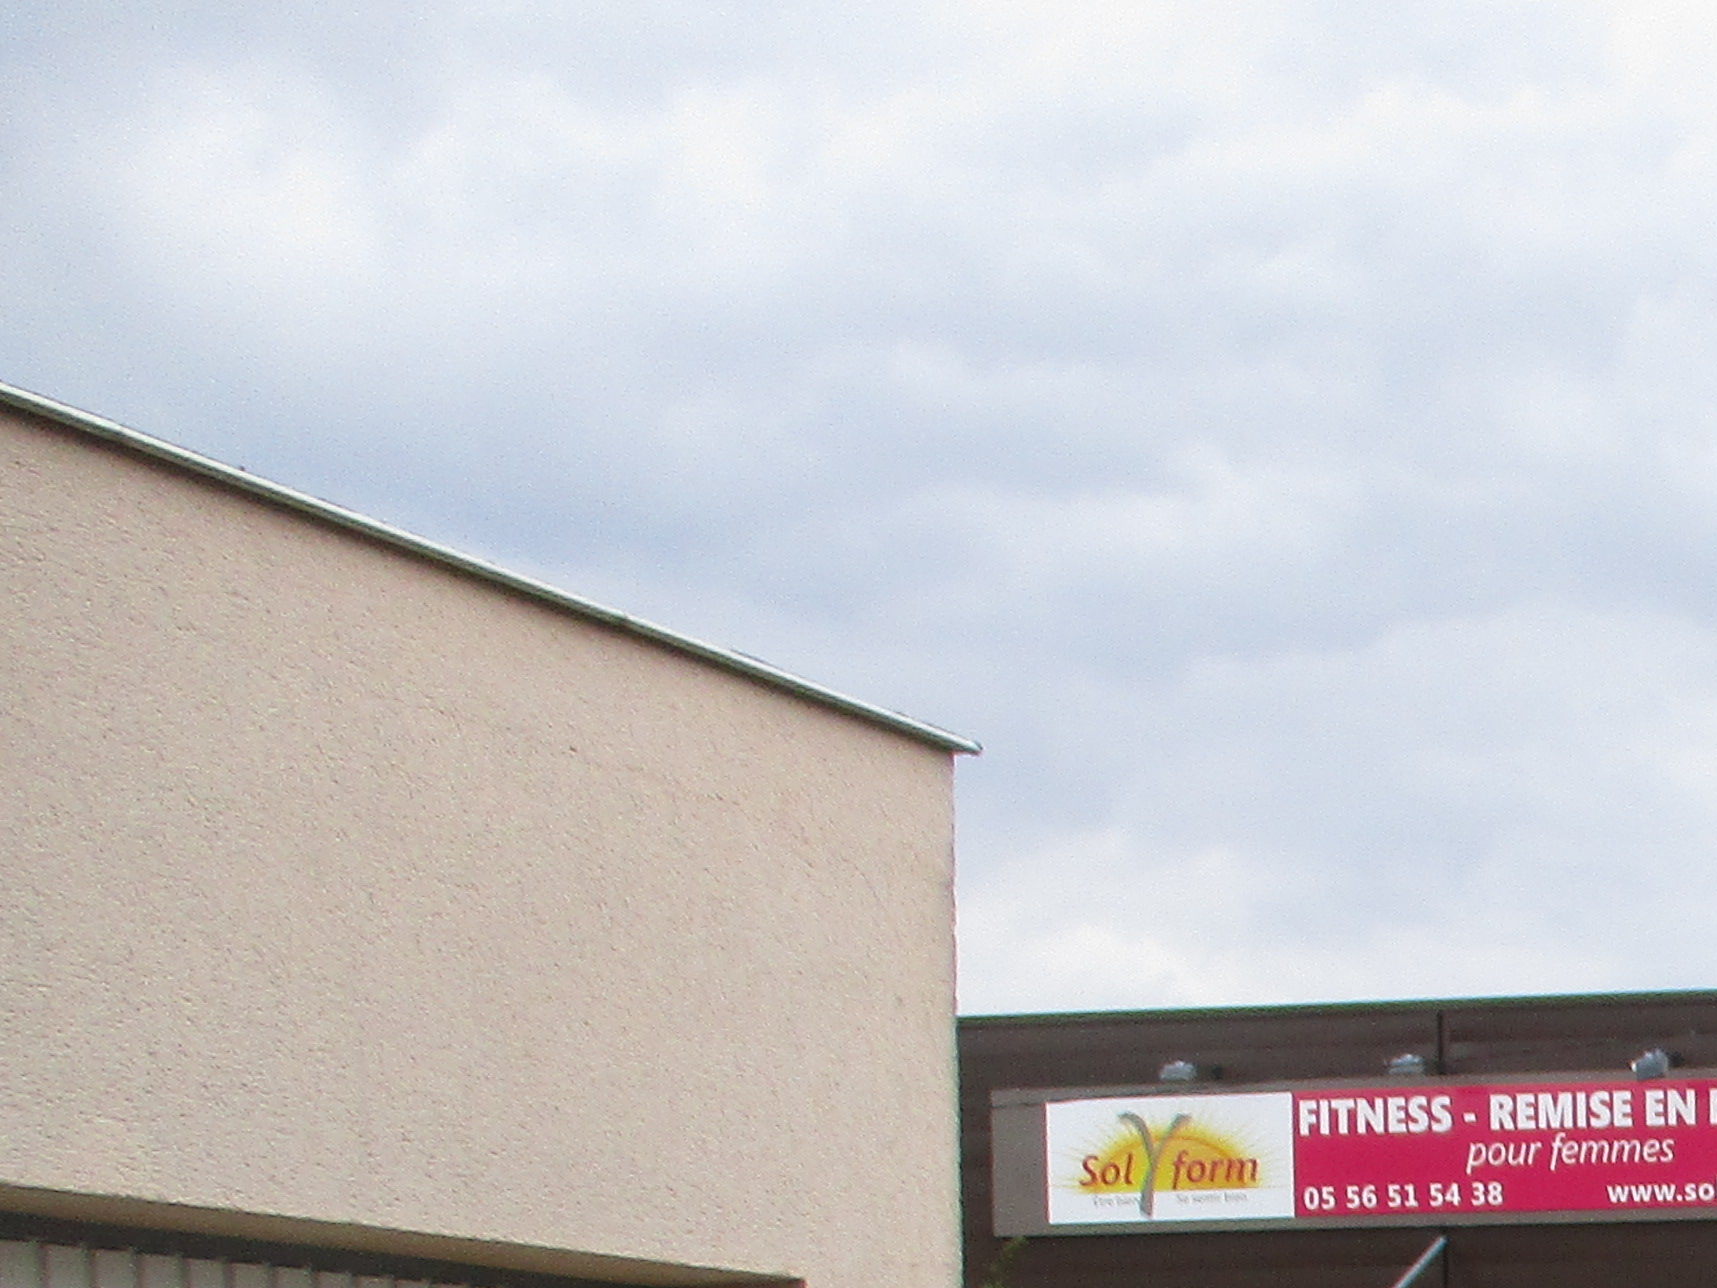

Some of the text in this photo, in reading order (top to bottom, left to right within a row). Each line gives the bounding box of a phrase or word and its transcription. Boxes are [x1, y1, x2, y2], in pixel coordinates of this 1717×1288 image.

[1299, 1095, 1453, 1136] FITNESS
[1490, 1090, 1633, 1132] REMISE
[1645, 1088, 1697, 1127] EN
[1466, 1132, 1675, 1175] pour femmes
[1303, 1181, 1504, 1210] 05 56 51 54 38
